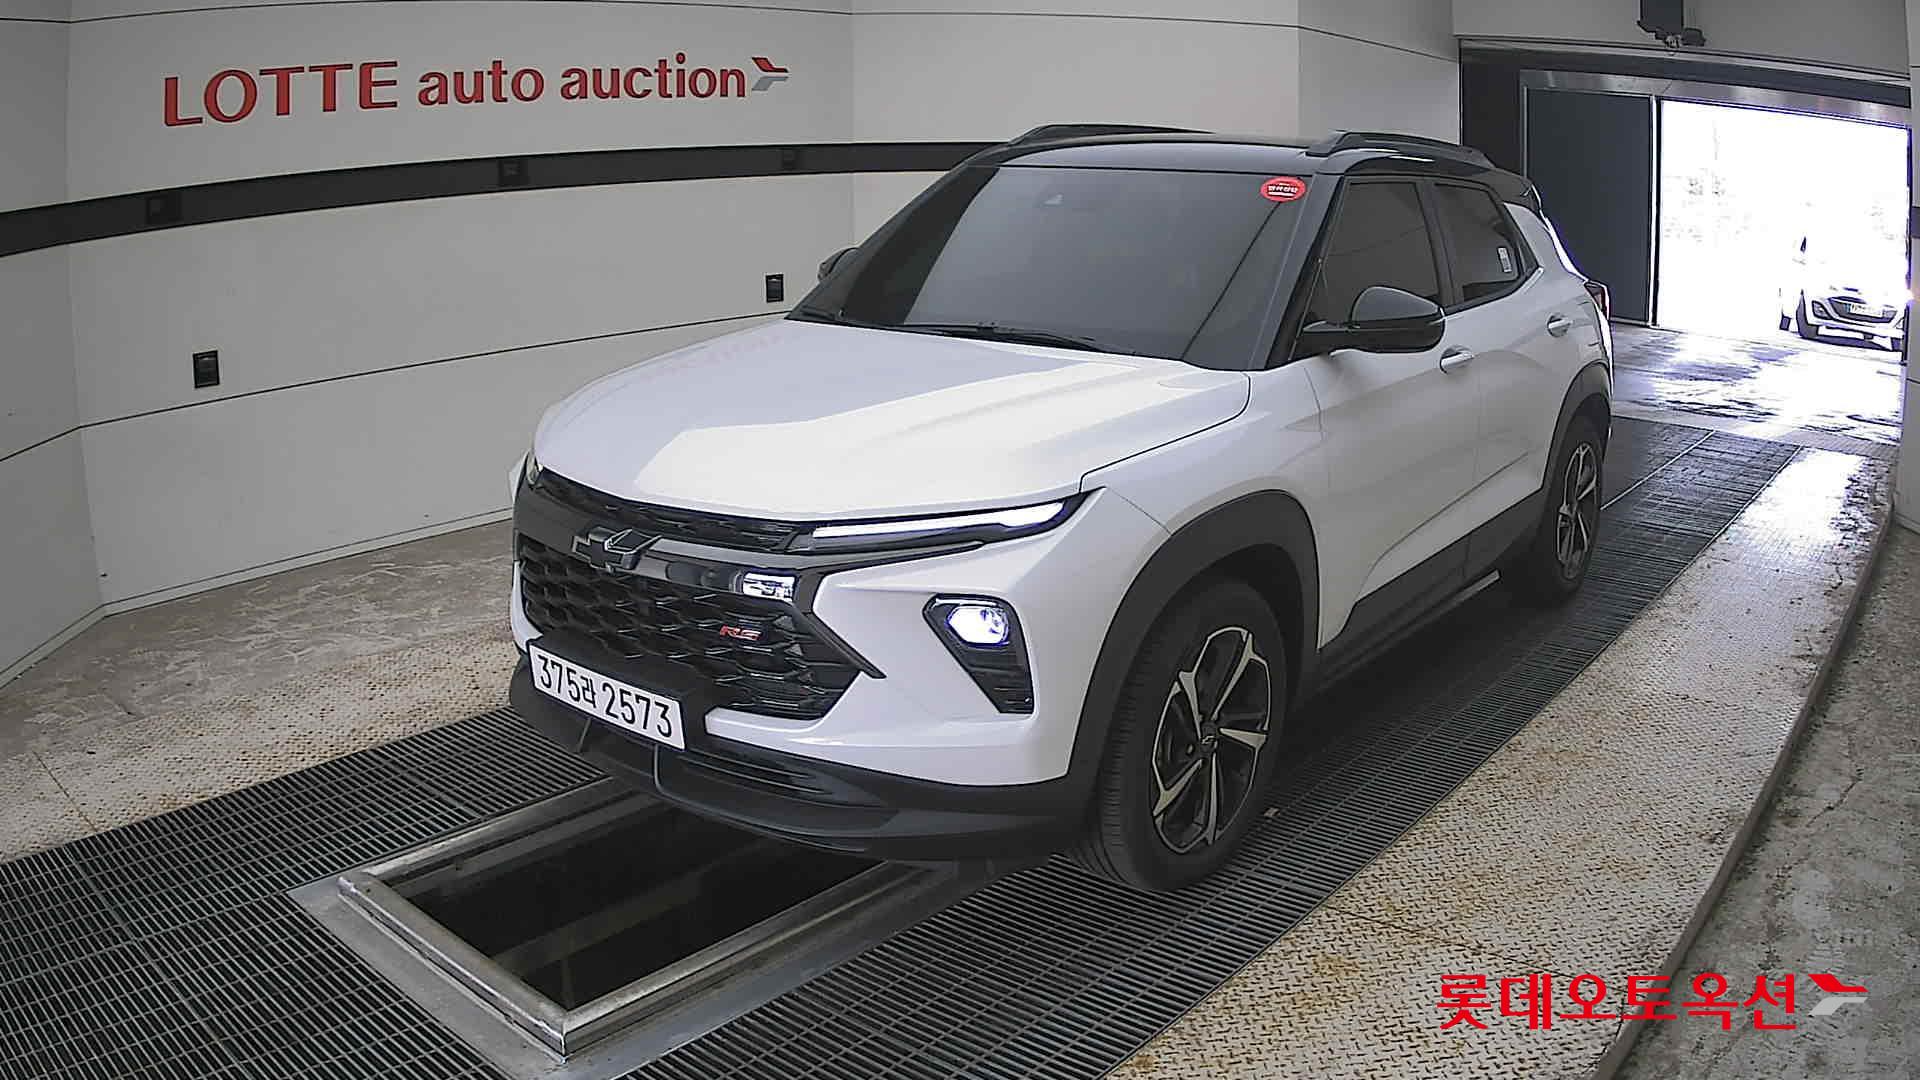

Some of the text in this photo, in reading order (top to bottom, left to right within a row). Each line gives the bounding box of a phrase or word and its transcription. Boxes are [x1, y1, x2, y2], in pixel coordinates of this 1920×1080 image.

[163, 52, 747, 127] LOTTE auto auction
[719, 624, 761, 641] RS
[537, 654, 673, 738] 375라 2573
